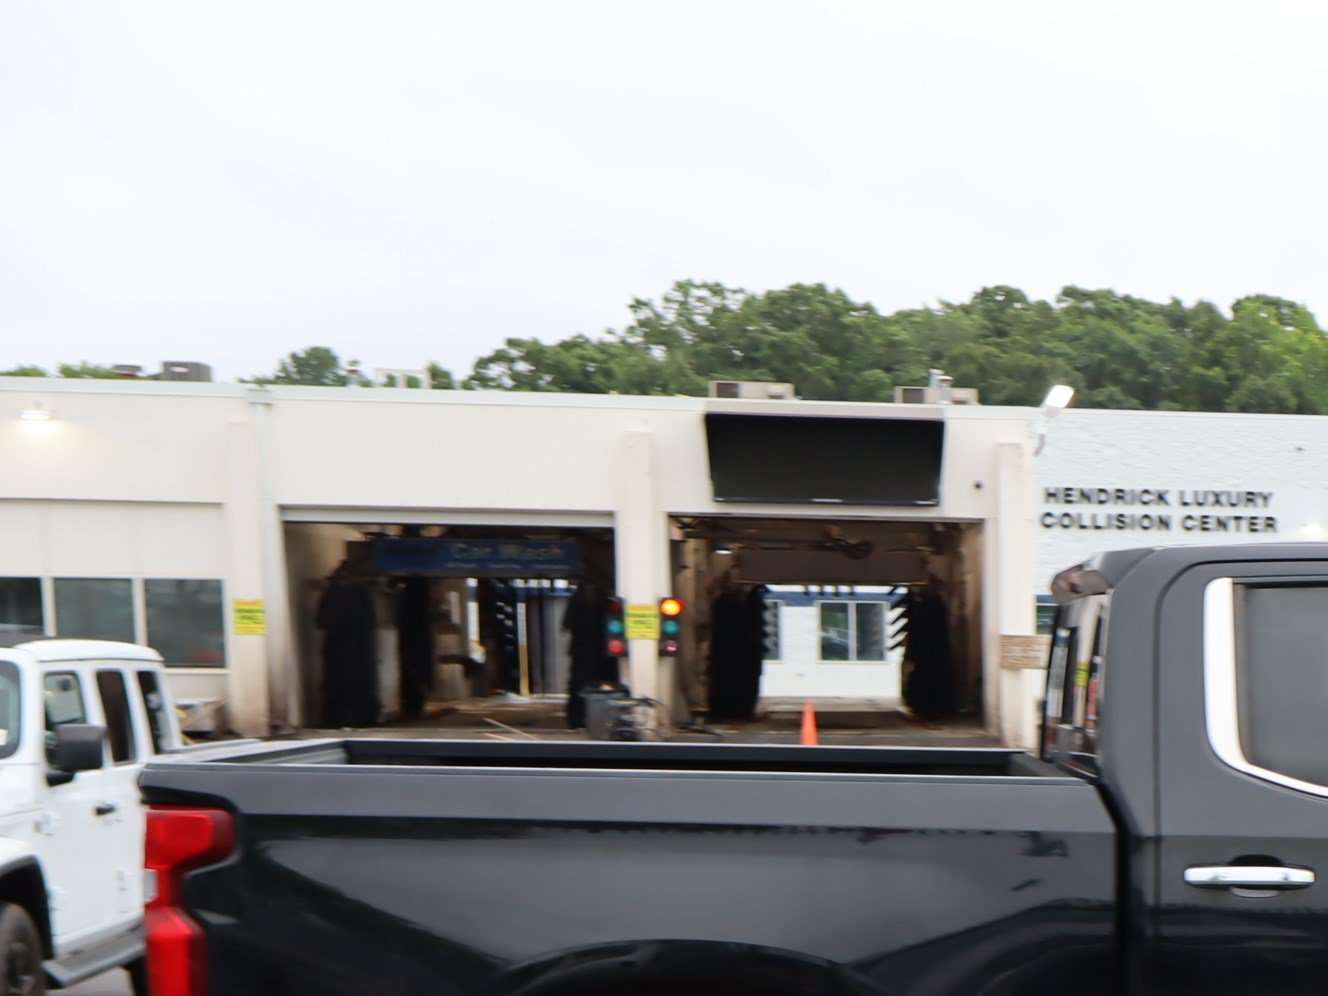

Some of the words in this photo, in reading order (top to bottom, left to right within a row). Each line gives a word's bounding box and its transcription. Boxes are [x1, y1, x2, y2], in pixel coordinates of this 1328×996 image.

[1044, 487, 1169, 506] HENDRICK
[1180, 490, 1273, 508] LUXURY
[1040, 512, 1171, 531] COLLISION
[1181, 514, 1278, 533] CENTER
